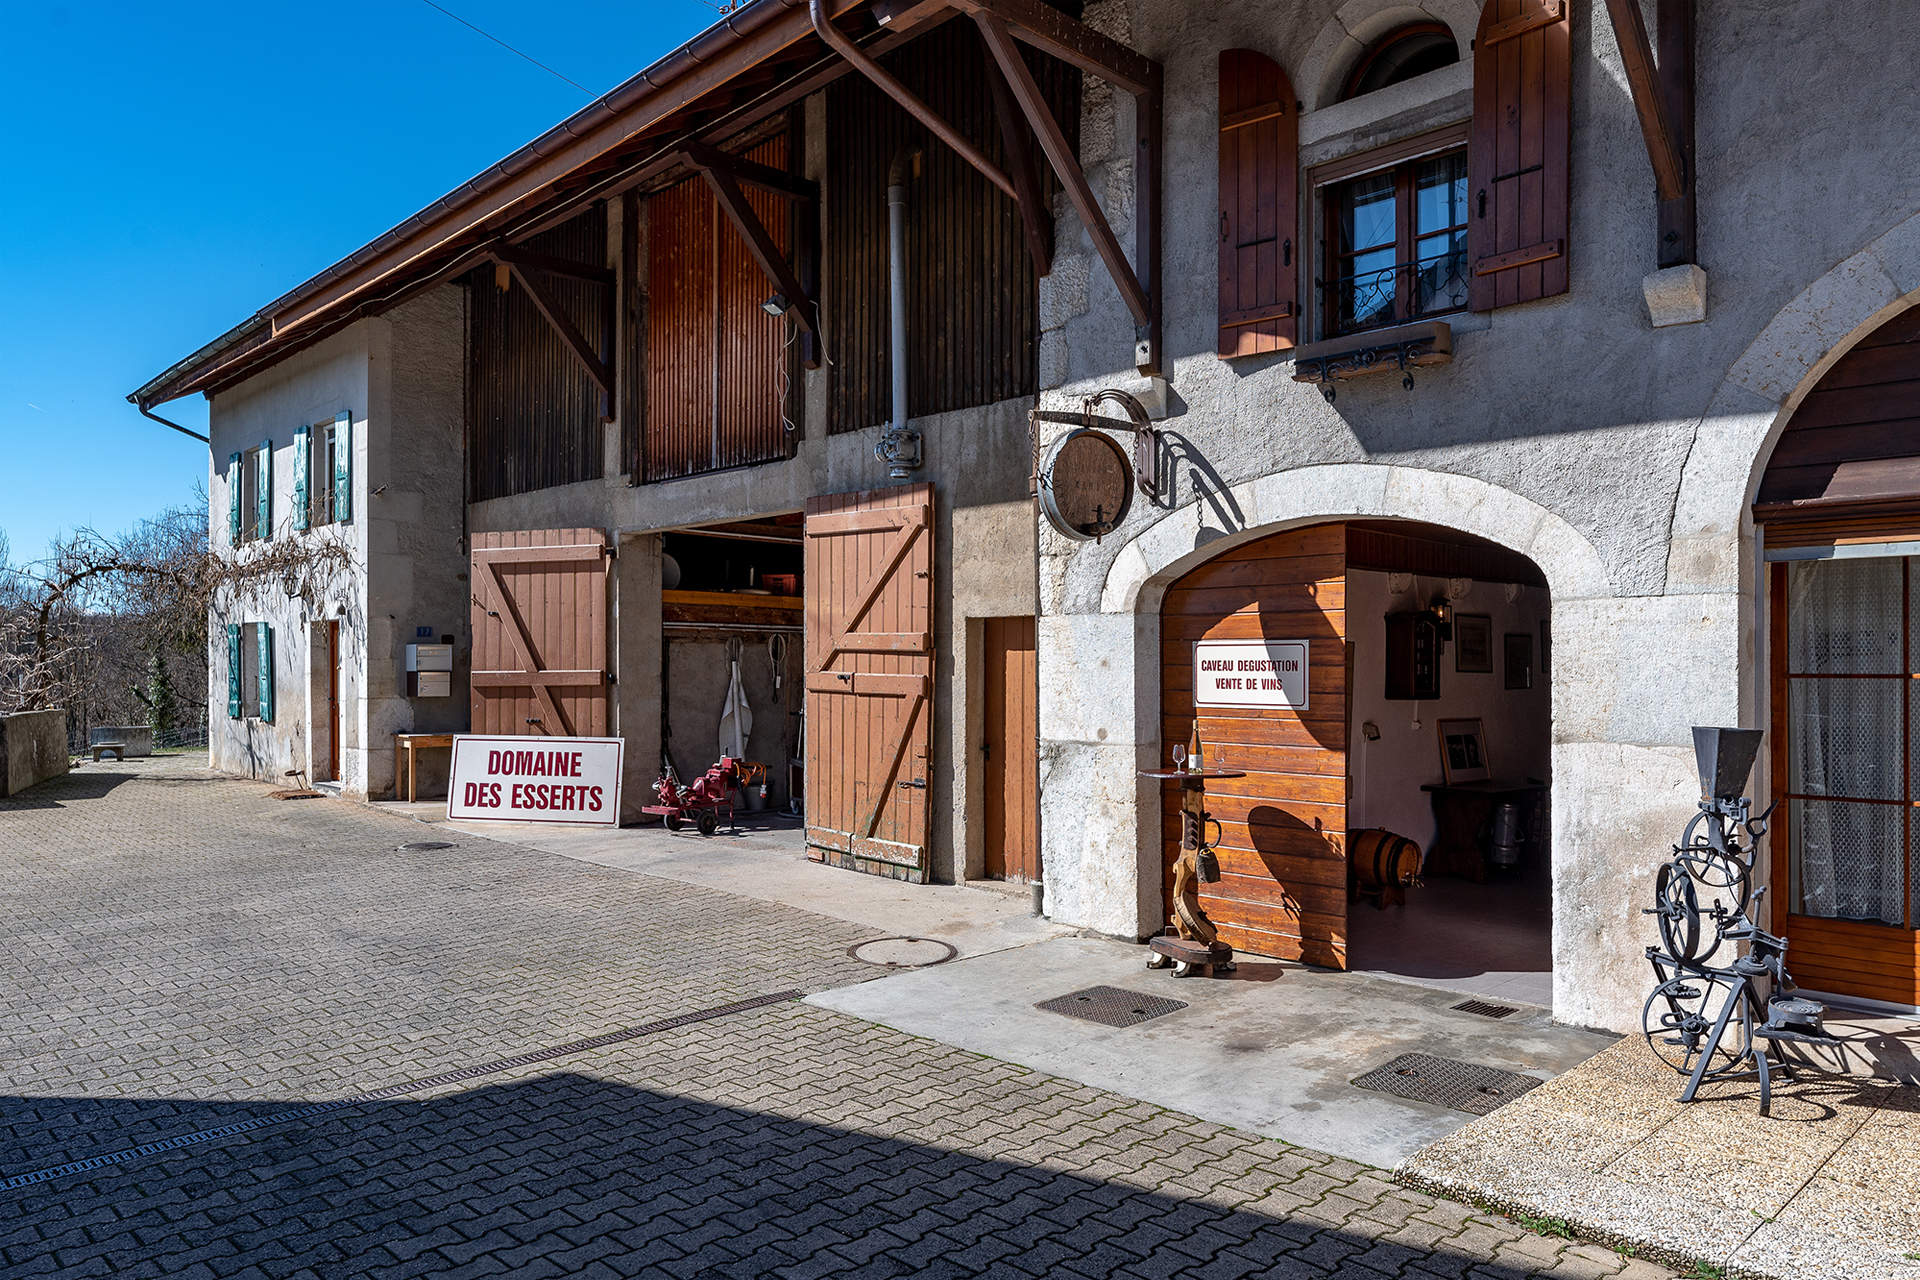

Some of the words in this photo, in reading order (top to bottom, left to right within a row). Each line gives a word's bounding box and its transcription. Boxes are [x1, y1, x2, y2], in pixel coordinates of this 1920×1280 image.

[1201, 660, 1234, 672] CAVEAU
[1237, 660, 1298, 672] DEGUSTATION
[1215, 678, 1242, 690] VENTE
[1246, 678, 1257, 690] DE
[1261, 678, 1283, 691] VINS
[487, 750, 582, 777] DOMAINE
[464, 782, 502, 808] DES
[511, 783, 603, 812] ESSERTS
